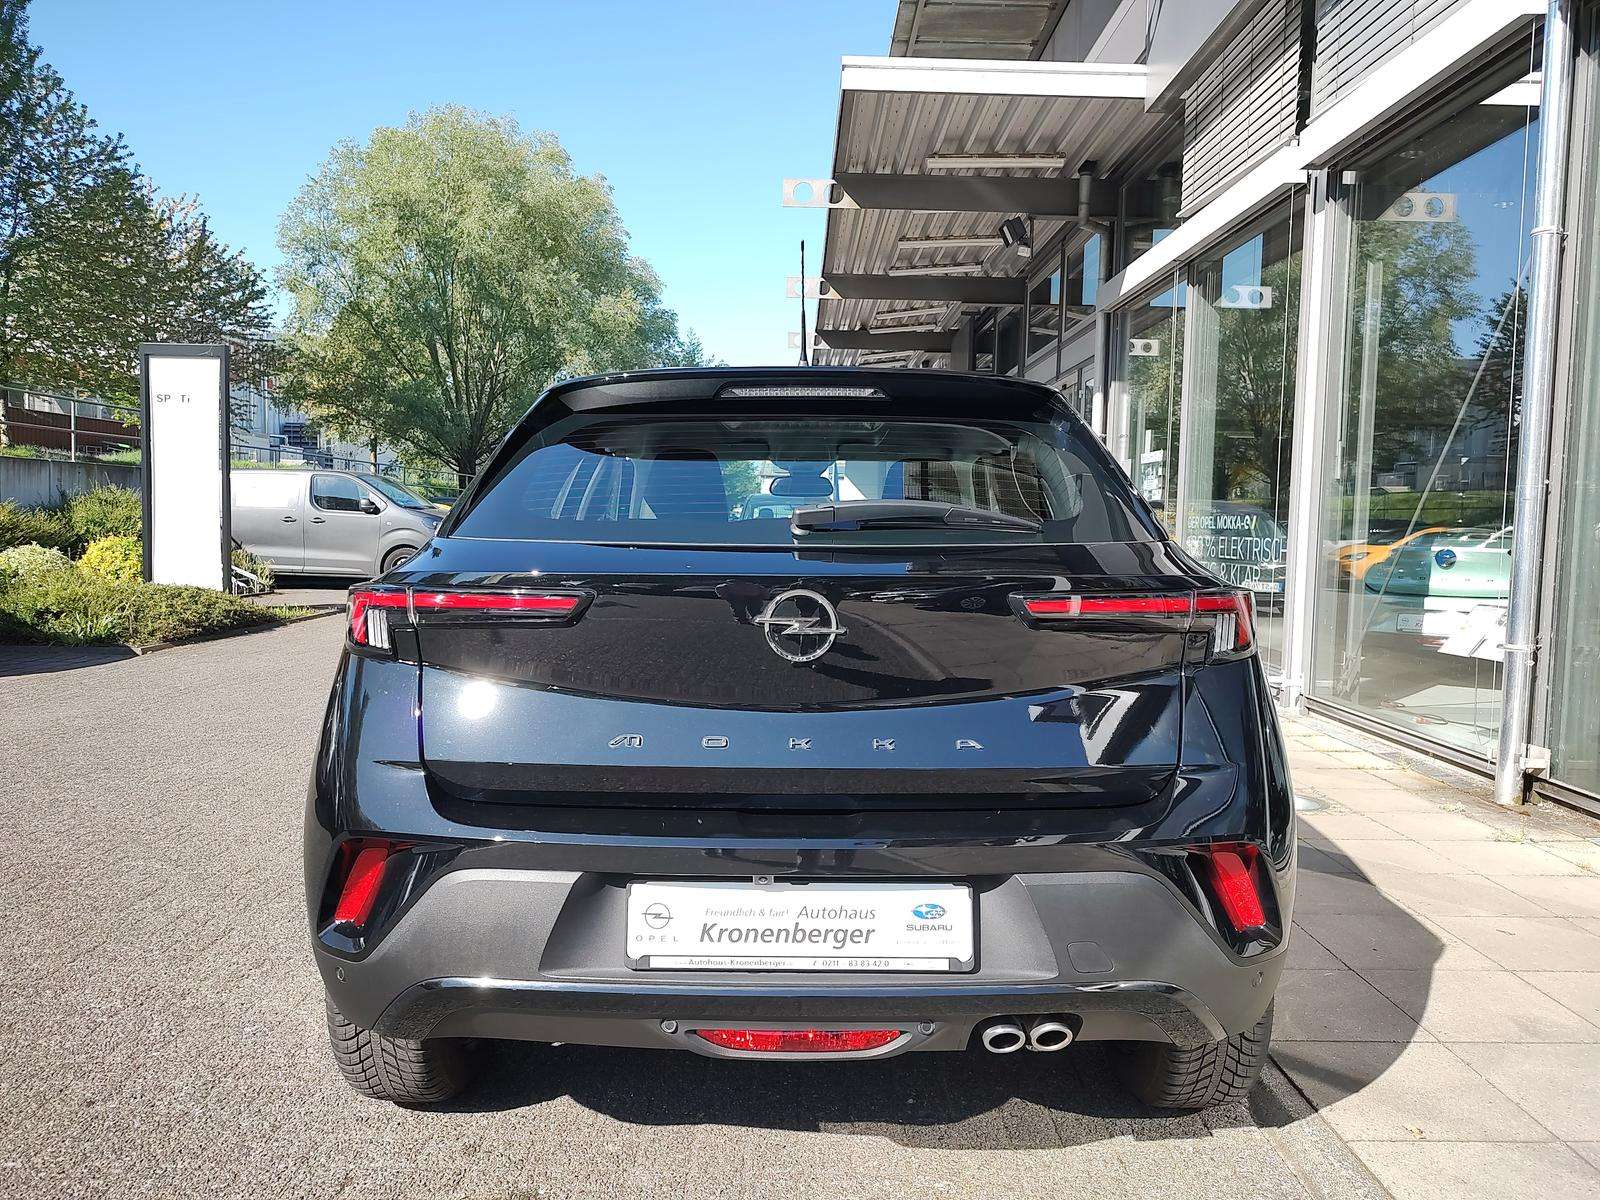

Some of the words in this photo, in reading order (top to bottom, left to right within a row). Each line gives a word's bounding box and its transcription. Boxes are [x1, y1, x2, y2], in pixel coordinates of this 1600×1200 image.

[1200, 515, 1215, 529] OPEL
[1218, 536, 1287, 563] ELEKTRISCH
[1230, 562, 1261, 586] KLAR
[608, 734, 985, 752] MOKKA
[797, 905, 876, 920] Autohaus
[699, 922, 876, 950] Kronenberger
[906, 924, 953, 932] SUBARU
[635, 934, 679, 943] OPEL
